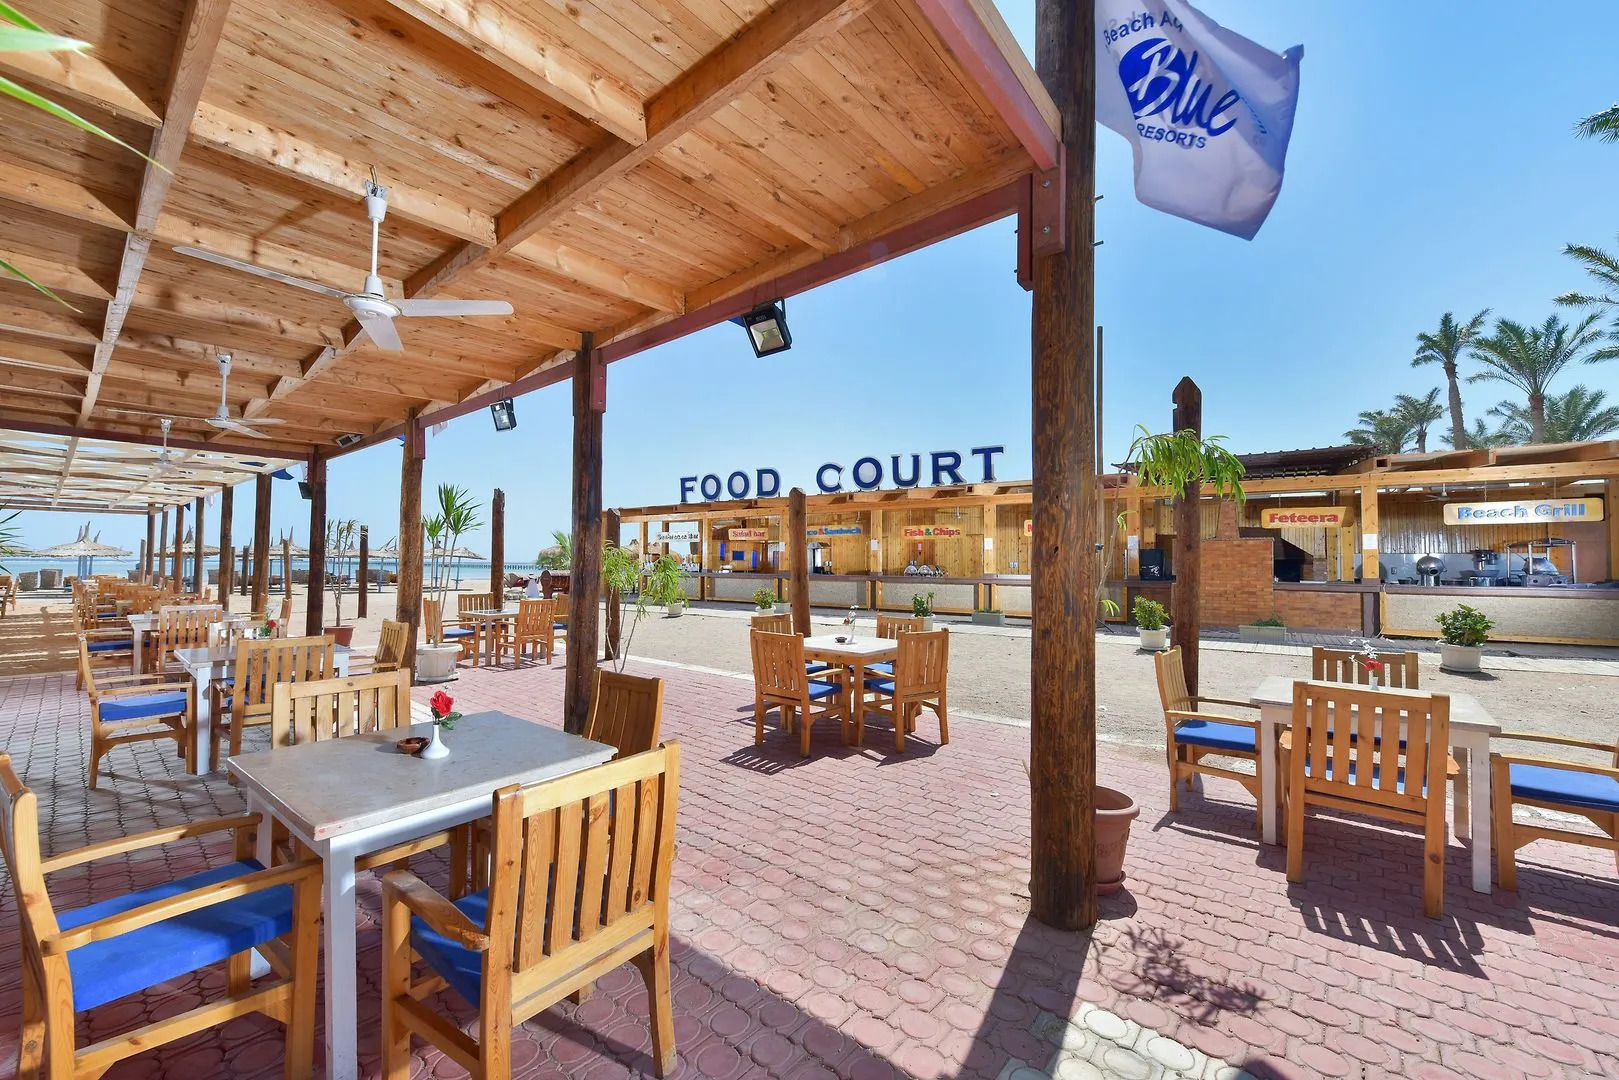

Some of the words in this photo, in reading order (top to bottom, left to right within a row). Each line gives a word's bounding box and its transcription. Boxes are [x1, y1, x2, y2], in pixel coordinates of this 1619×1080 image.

[1103, 12, 1155, 46] Beach
[1126, 38, 1242, 137] Blue
[1136, 123, 1208, 149] RESORTS
[679, 468, 781, 503] FOOD
[815, 446, 1005, 493] COURT
[1269, 512, 1339, 523] Feteera
[1457, 505, 1529, 519] Beach
[1534, 503, 1586, 518] Grill
[904, 528, 924, 537] Fish
[924, 528, 932, 536] &
[932, 527, 961, 538] Chips
